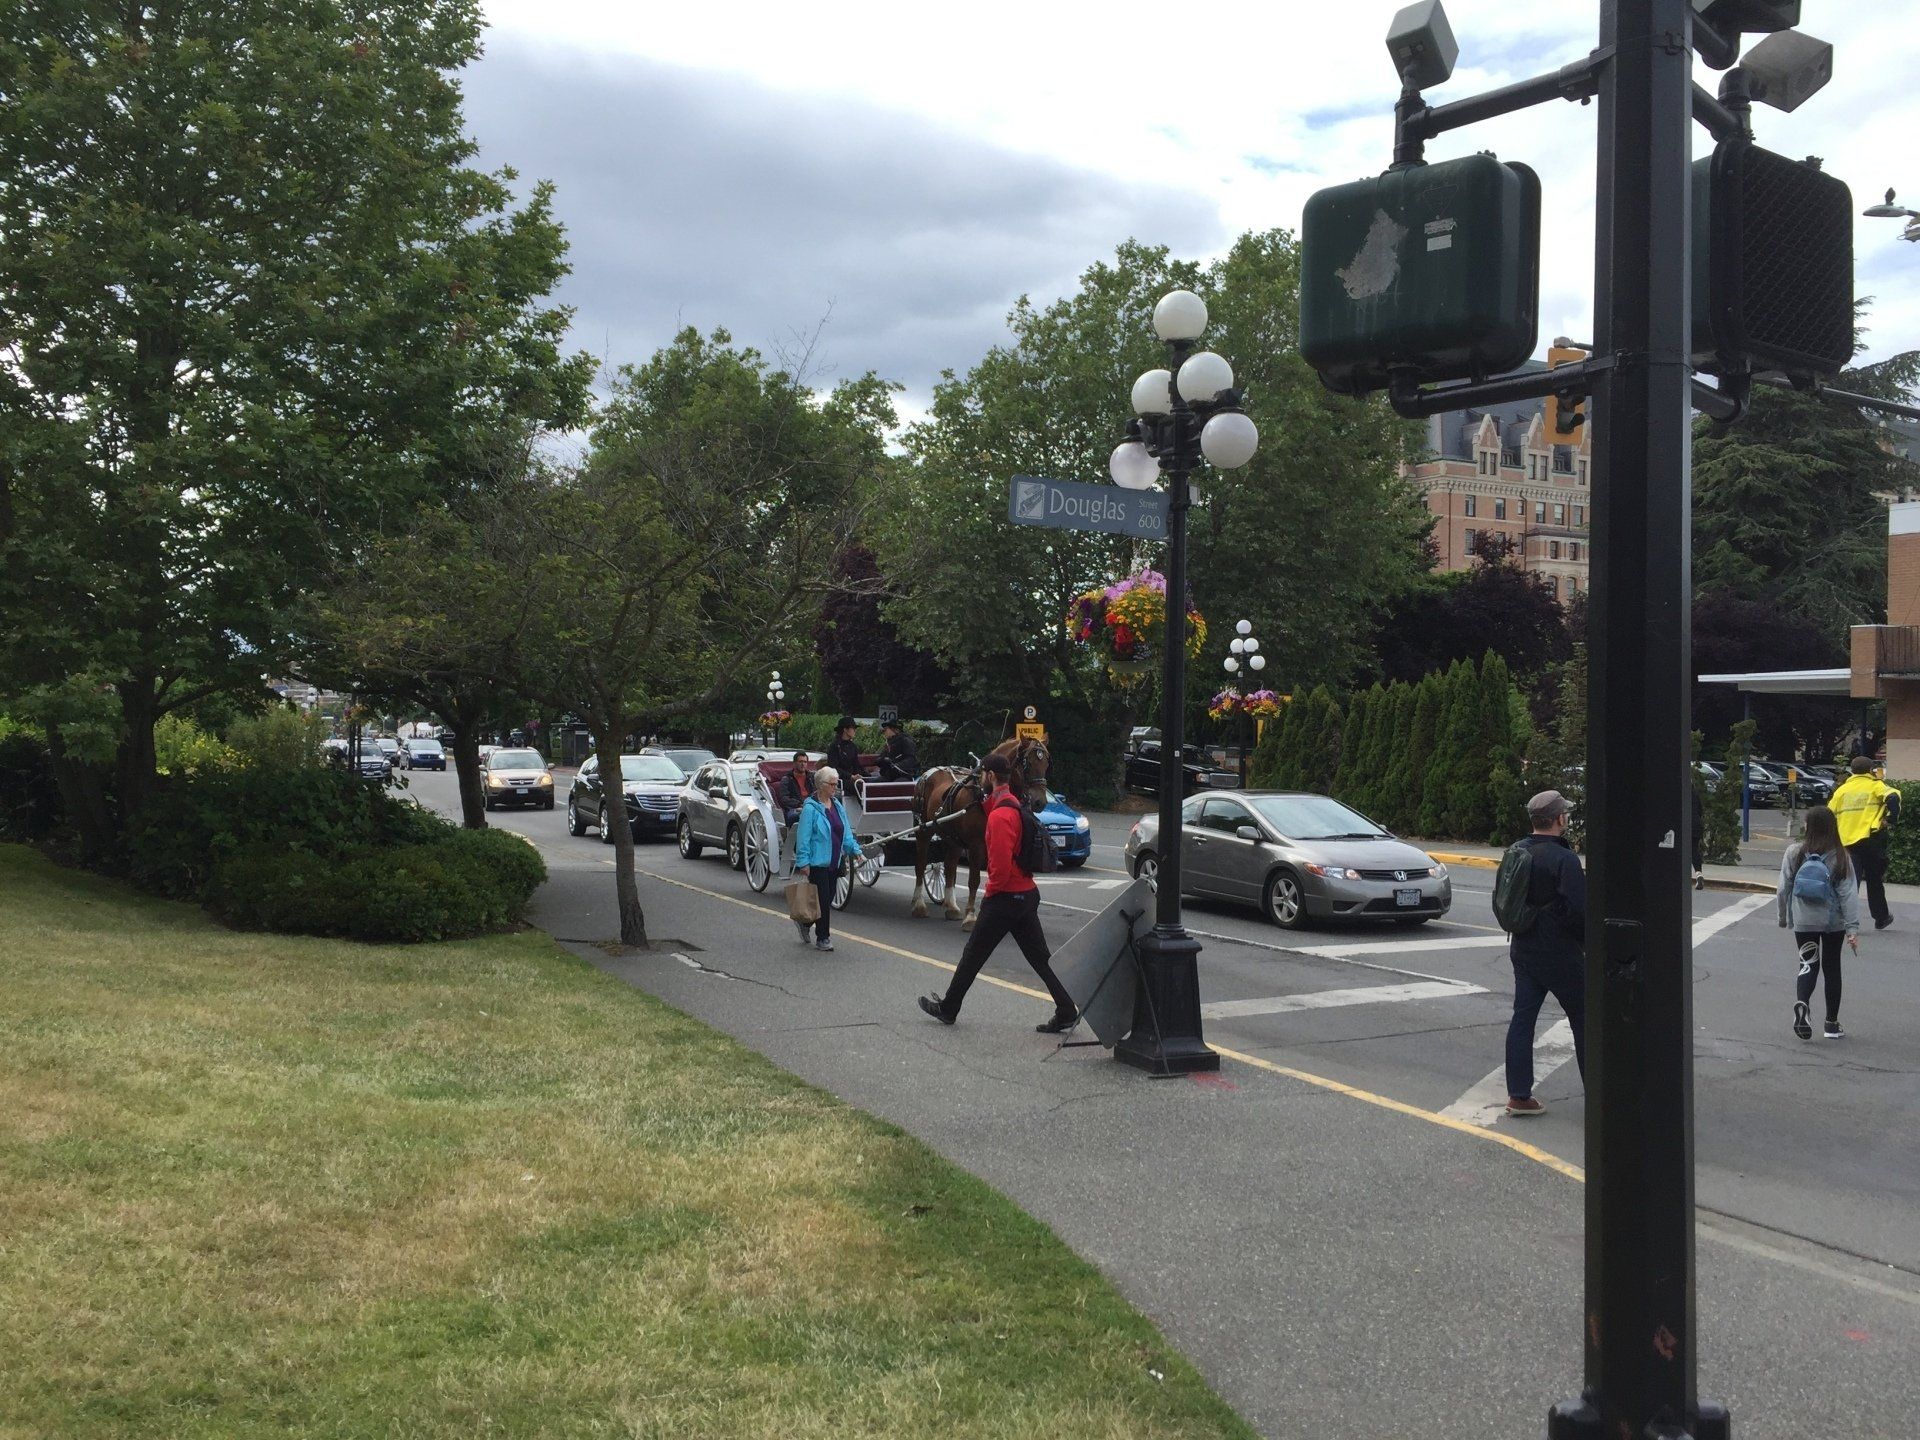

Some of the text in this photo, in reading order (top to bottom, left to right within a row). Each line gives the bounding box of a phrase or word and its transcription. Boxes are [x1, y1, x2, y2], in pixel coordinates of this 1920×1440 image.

[1049, 488, 1161, 530] Douglas 600
[880, 711, 897, 722] 40
